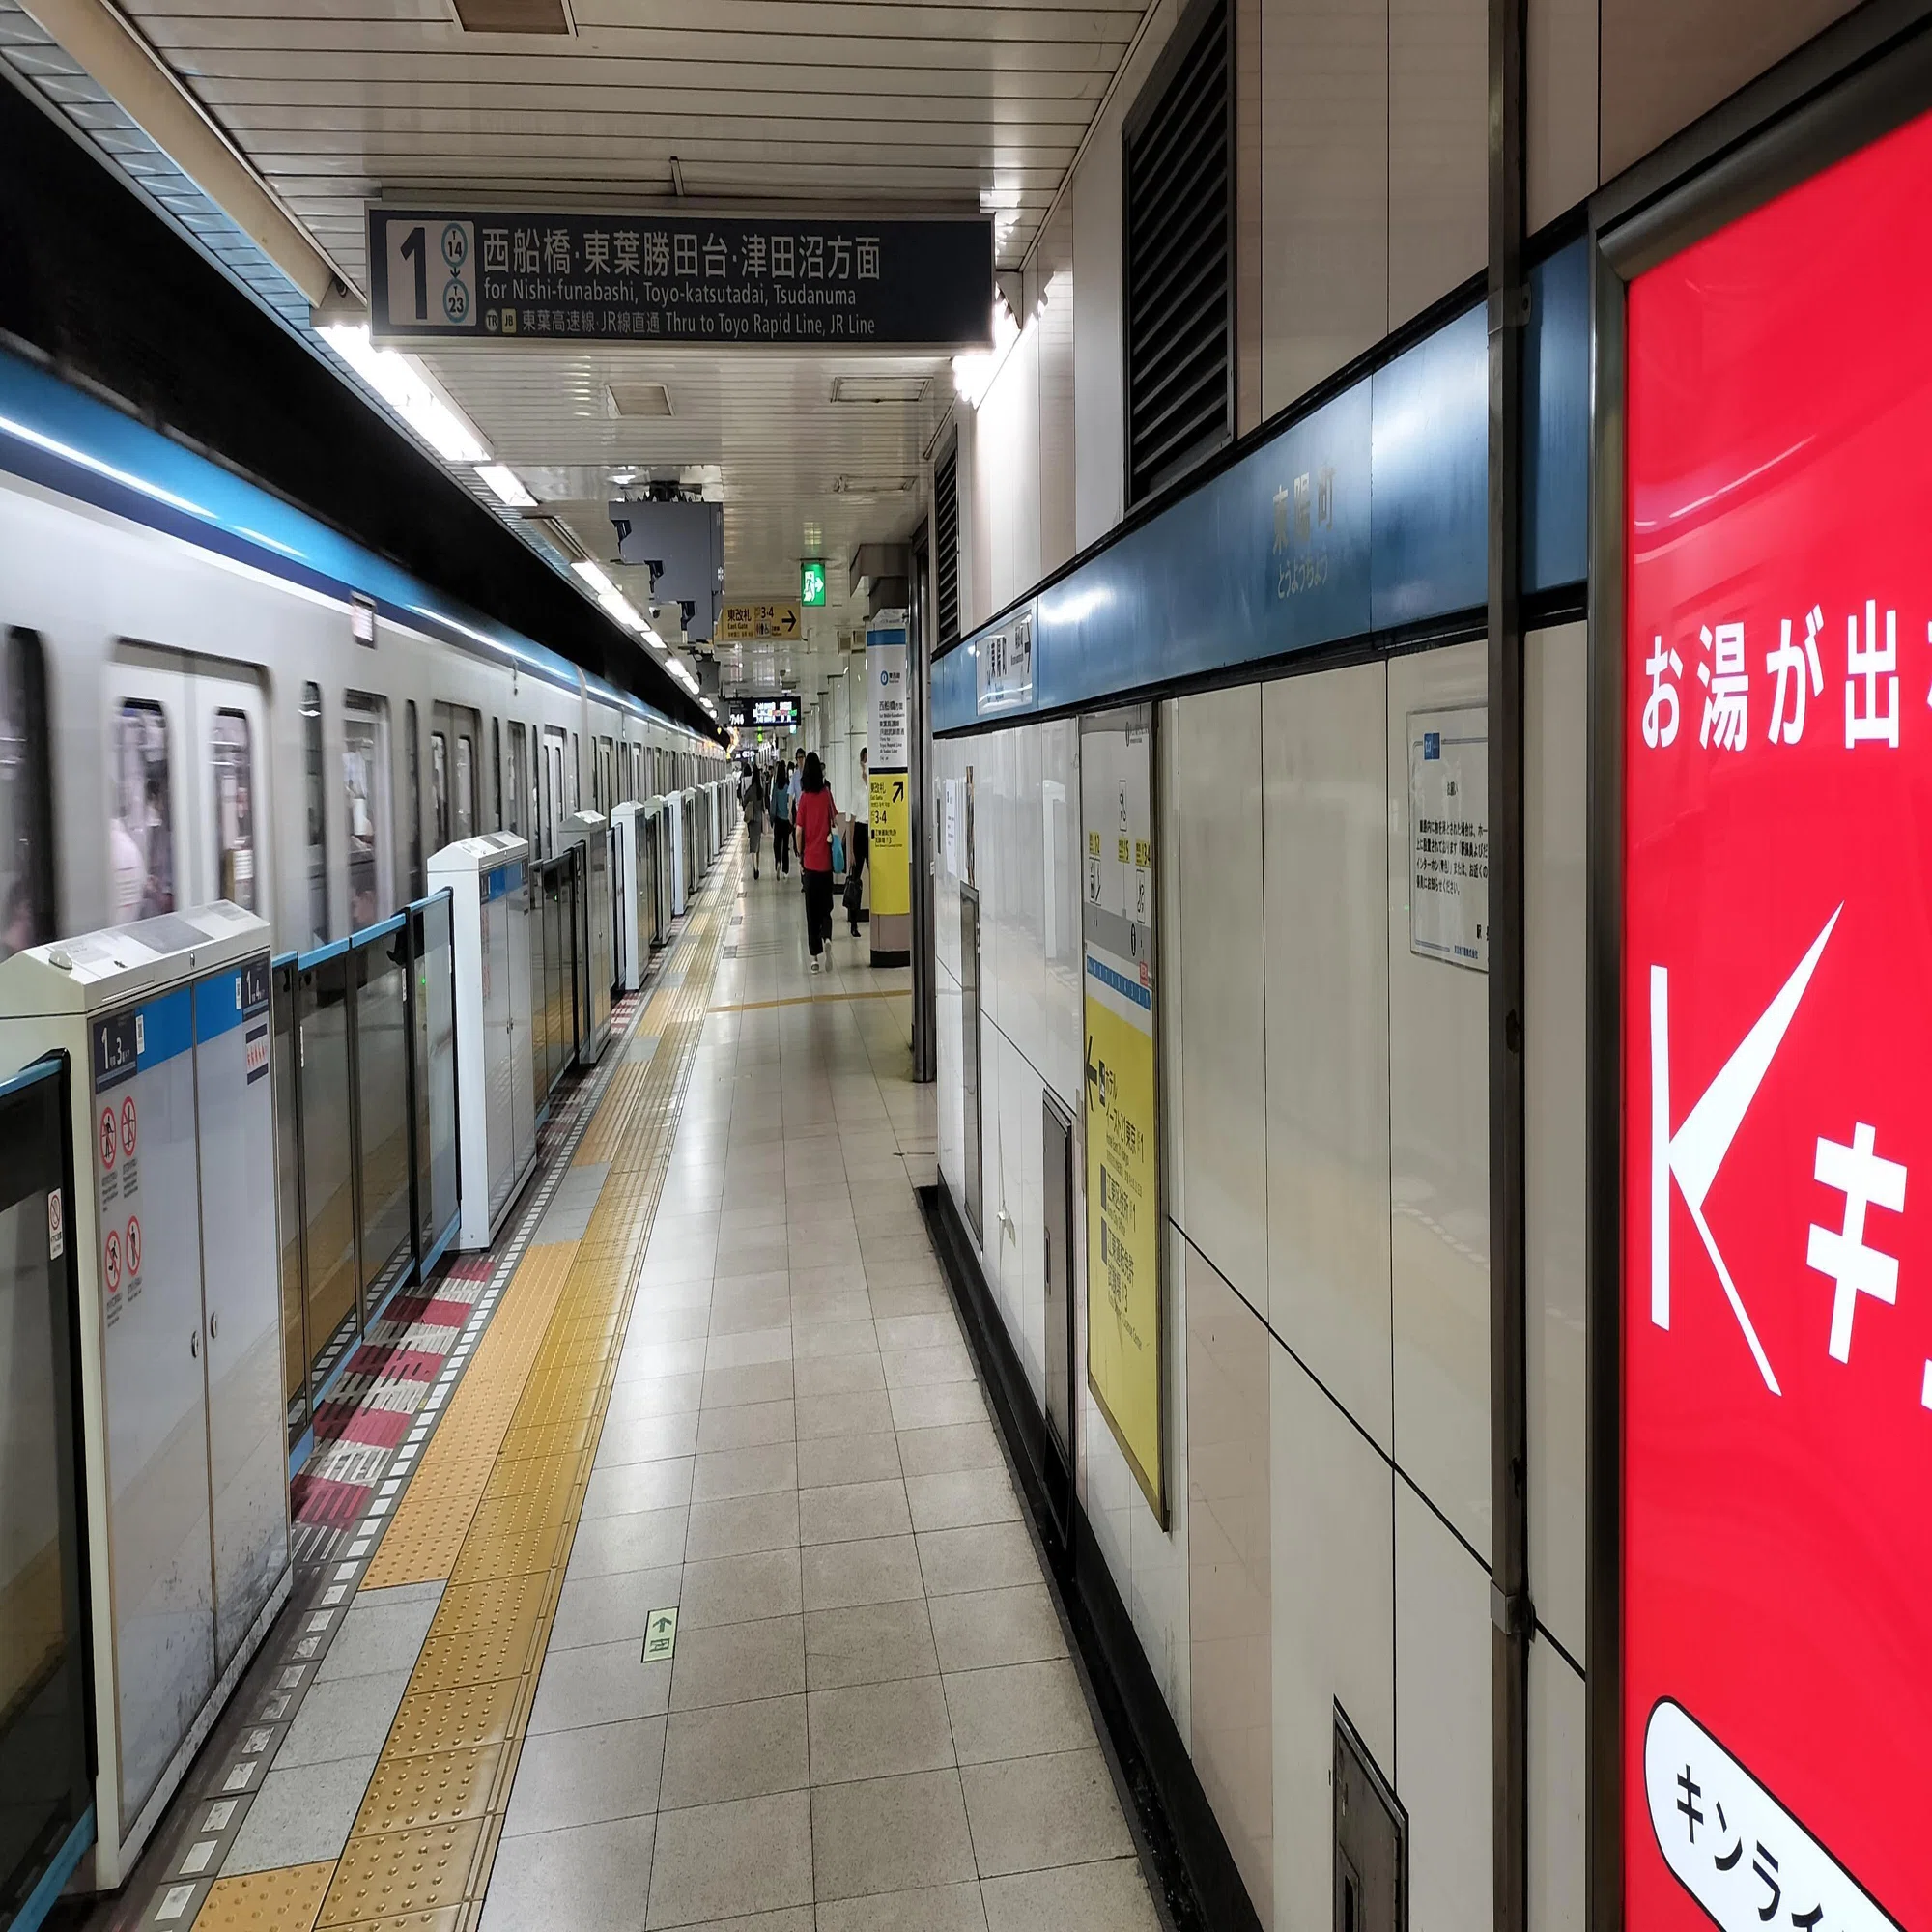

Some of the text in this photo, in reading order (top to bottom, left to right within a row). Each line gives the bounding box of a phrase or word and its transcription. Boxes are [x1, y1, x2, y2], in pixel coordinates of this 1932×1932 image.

[447, 242, 463, 258] 14
[400, 227, 428, 321] 1
[448, 297, 465, 313] 23
[484, 276, 856, 308] for Nishi-funabashi, Toyo-katsutadai, Tsudanuma
[486, 314, 497, 327] TR
[666, 311, 696, 333] Thru
[700, 314, 714, 333] to
[719, 313, 749, 339] Toyo
[753, 313, 791, 339] Rapid
[796, 314, 826, 337] Line,
[830, 314, 844, 335] JR
[849, 314, 875, 334] Line
[1273, 464, 1336, 555] 東陽町
[727, 608, 752, 622] 東改札
[1642, 599, 1932, 752] お湯が出
